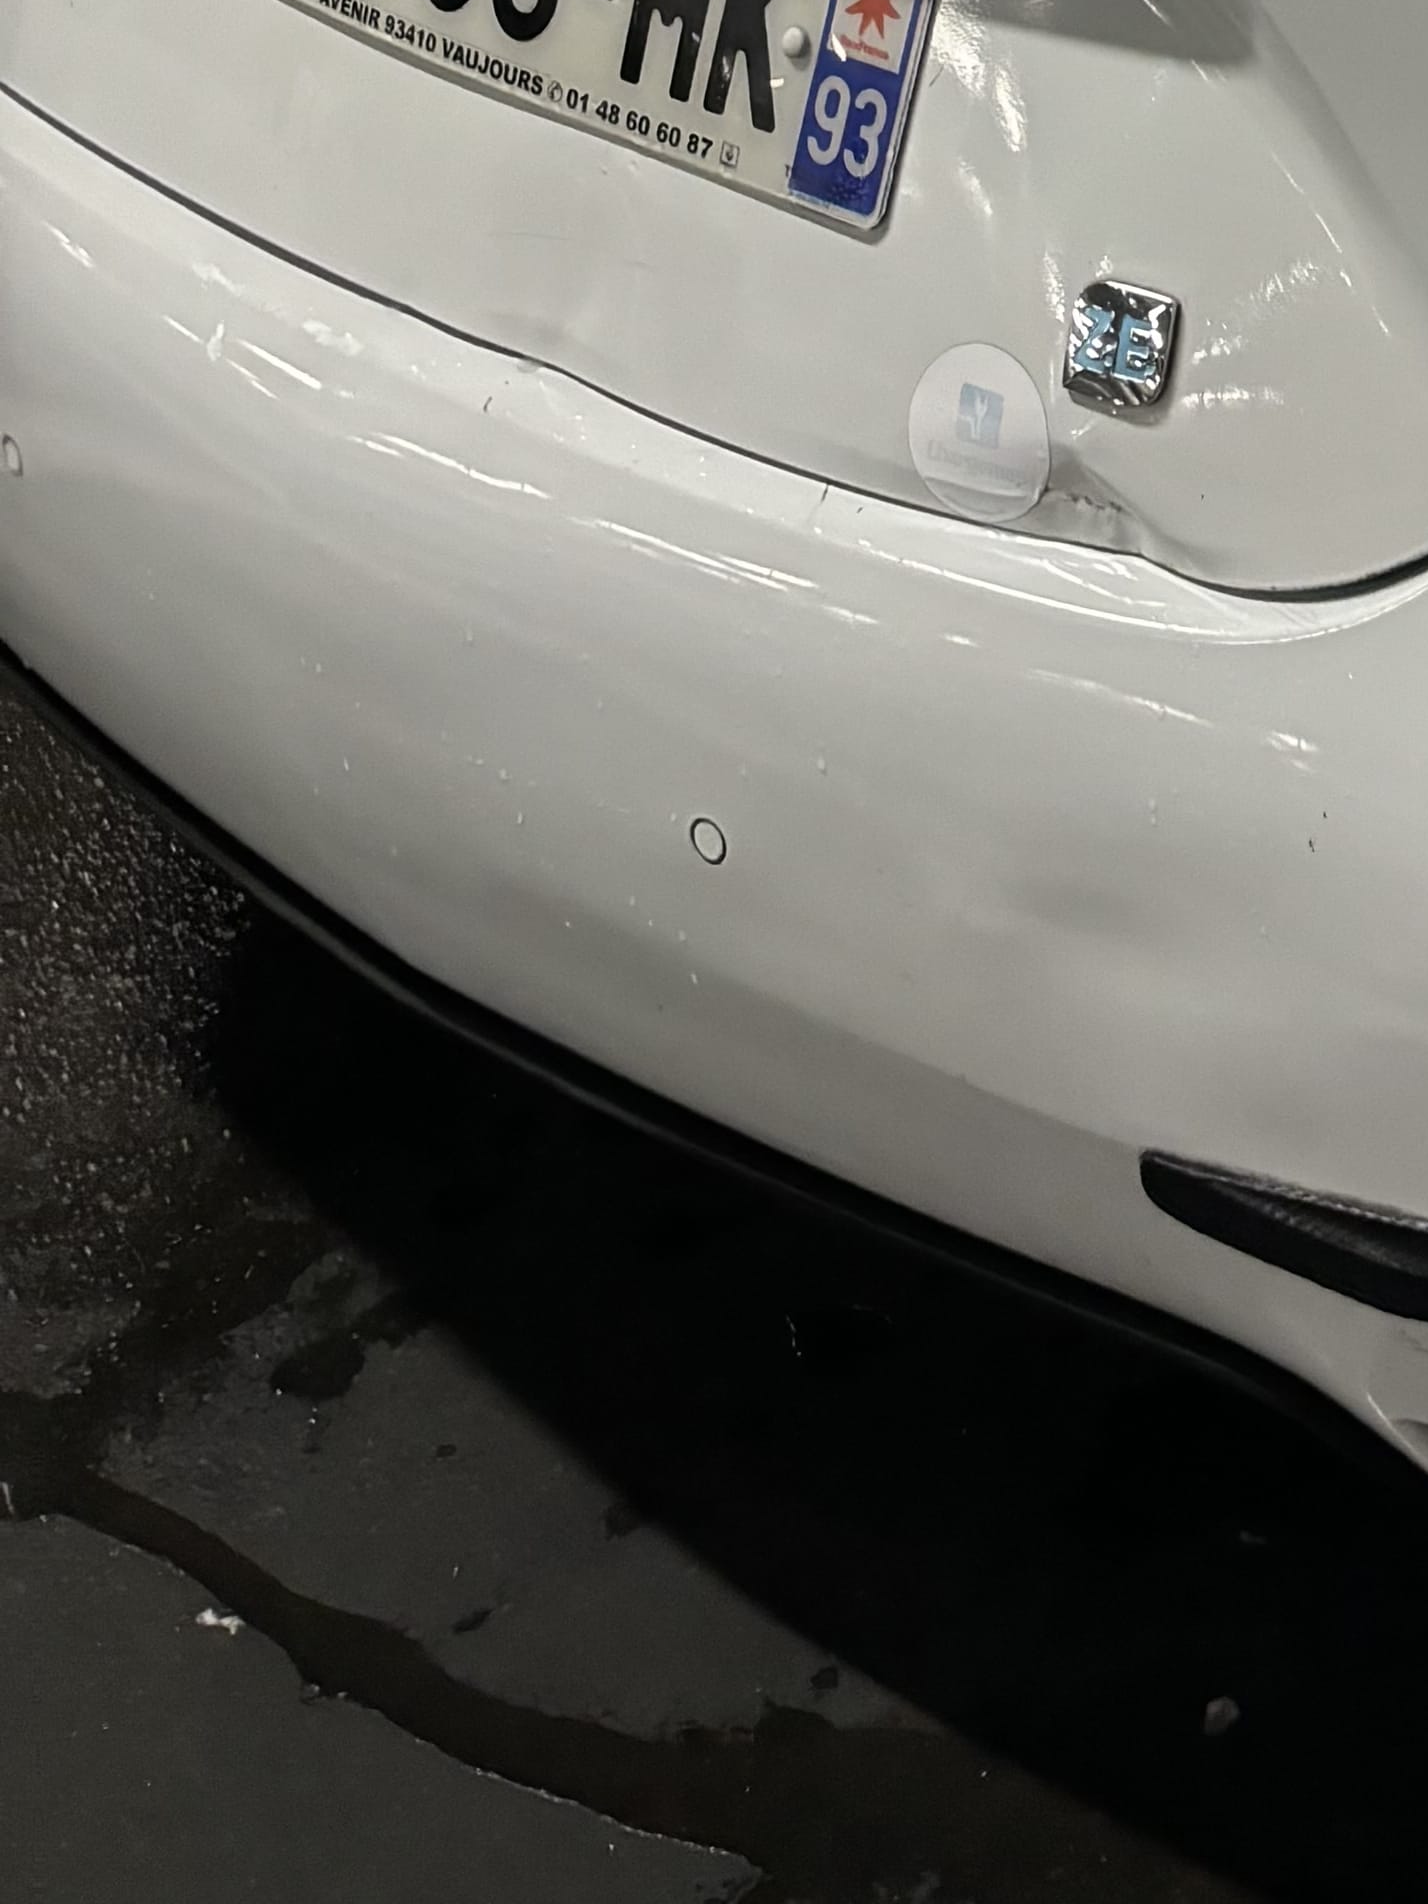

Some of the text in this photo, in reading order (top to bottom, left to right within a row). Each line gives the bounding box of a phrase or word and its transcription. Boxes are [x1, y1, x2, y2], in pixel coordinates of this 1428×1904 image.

[385, 15, 437, 53] 93410
[442, 38, 545, 96] VAUJOURS
[566, 88, 590, 113] 01
[595, 100, 620, 125] 48
[626, 110, 650, 136] 60
[656, 122, 681, 147] 60
[686, 133, 714, 159] 87
[807, 75, 888, 177] 93
